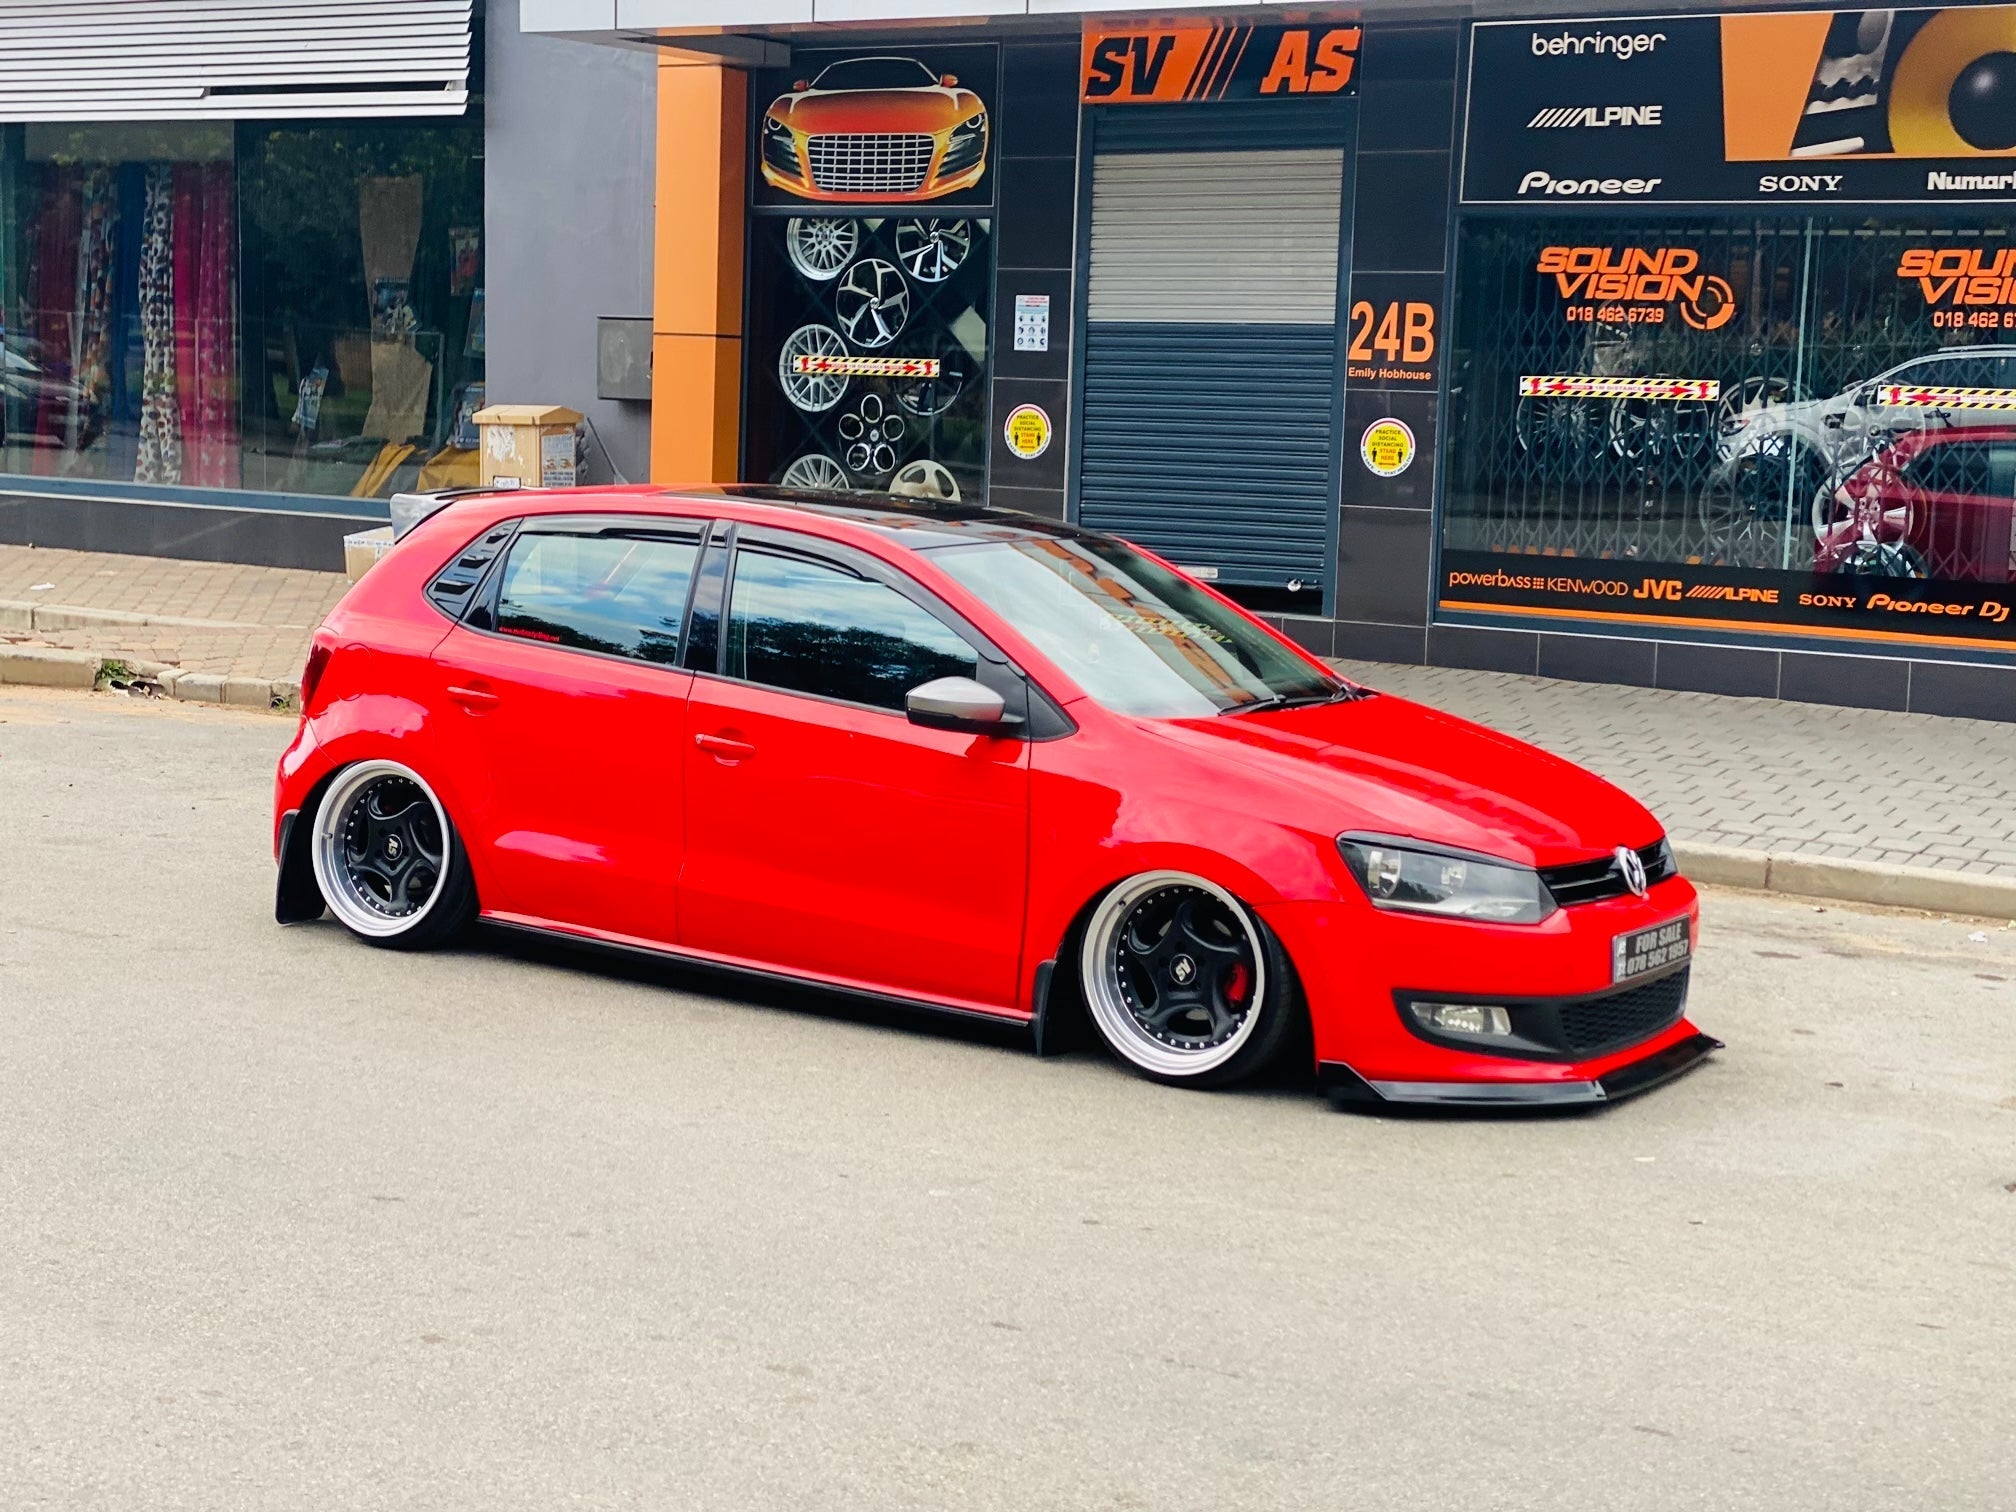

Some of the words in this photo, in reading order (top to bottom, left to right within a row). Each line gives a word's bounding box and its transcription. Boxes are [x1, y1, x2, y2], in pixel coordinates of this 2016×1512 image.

[1532, 31, 1667, 60] behringer
[1085, 36, 1176, 96] SV
[1259, 29, 1361, 94] AS
[1568, 105, 1663, 127] ALPINE
[1517, 170, 1662, 195] Pioneer
[1759, 175, 1843, 192] SONY
[1927, 171, 2016, 190] Numar
[1536, 247, 1699, 275] SOUND
[1556, 273, 1704, 301] VISION
[1919, 276, 2016, 305] VISI
[1566, 306, 1594, 322] 018
[1597, 307, 1625, 322] 462
[1628, 307, 1665, 323] 6739
[1933, 311, 1964, 328] 018
[1968, 312, 1999, 328] 462
[1348, 301, 1435, 363] 24B
[1348, 367, 1377, 380] Emily
[1378, 368, 1432, 380] Hobhouse
[1449, 568, 1531, 589] powerbass
[1547, 578, 1629, 596] KENWOOD
[1633, 579, 1683, 601] JVC
[1714, 586, 1779, 603] ALPINE
[1799, 594, 1857, 608] SONY
[1866, 594, 1974, 616] Pioneer
[1635, 932, 1658, 954] FOR
[1658, 922, 1682, 946] SALE
